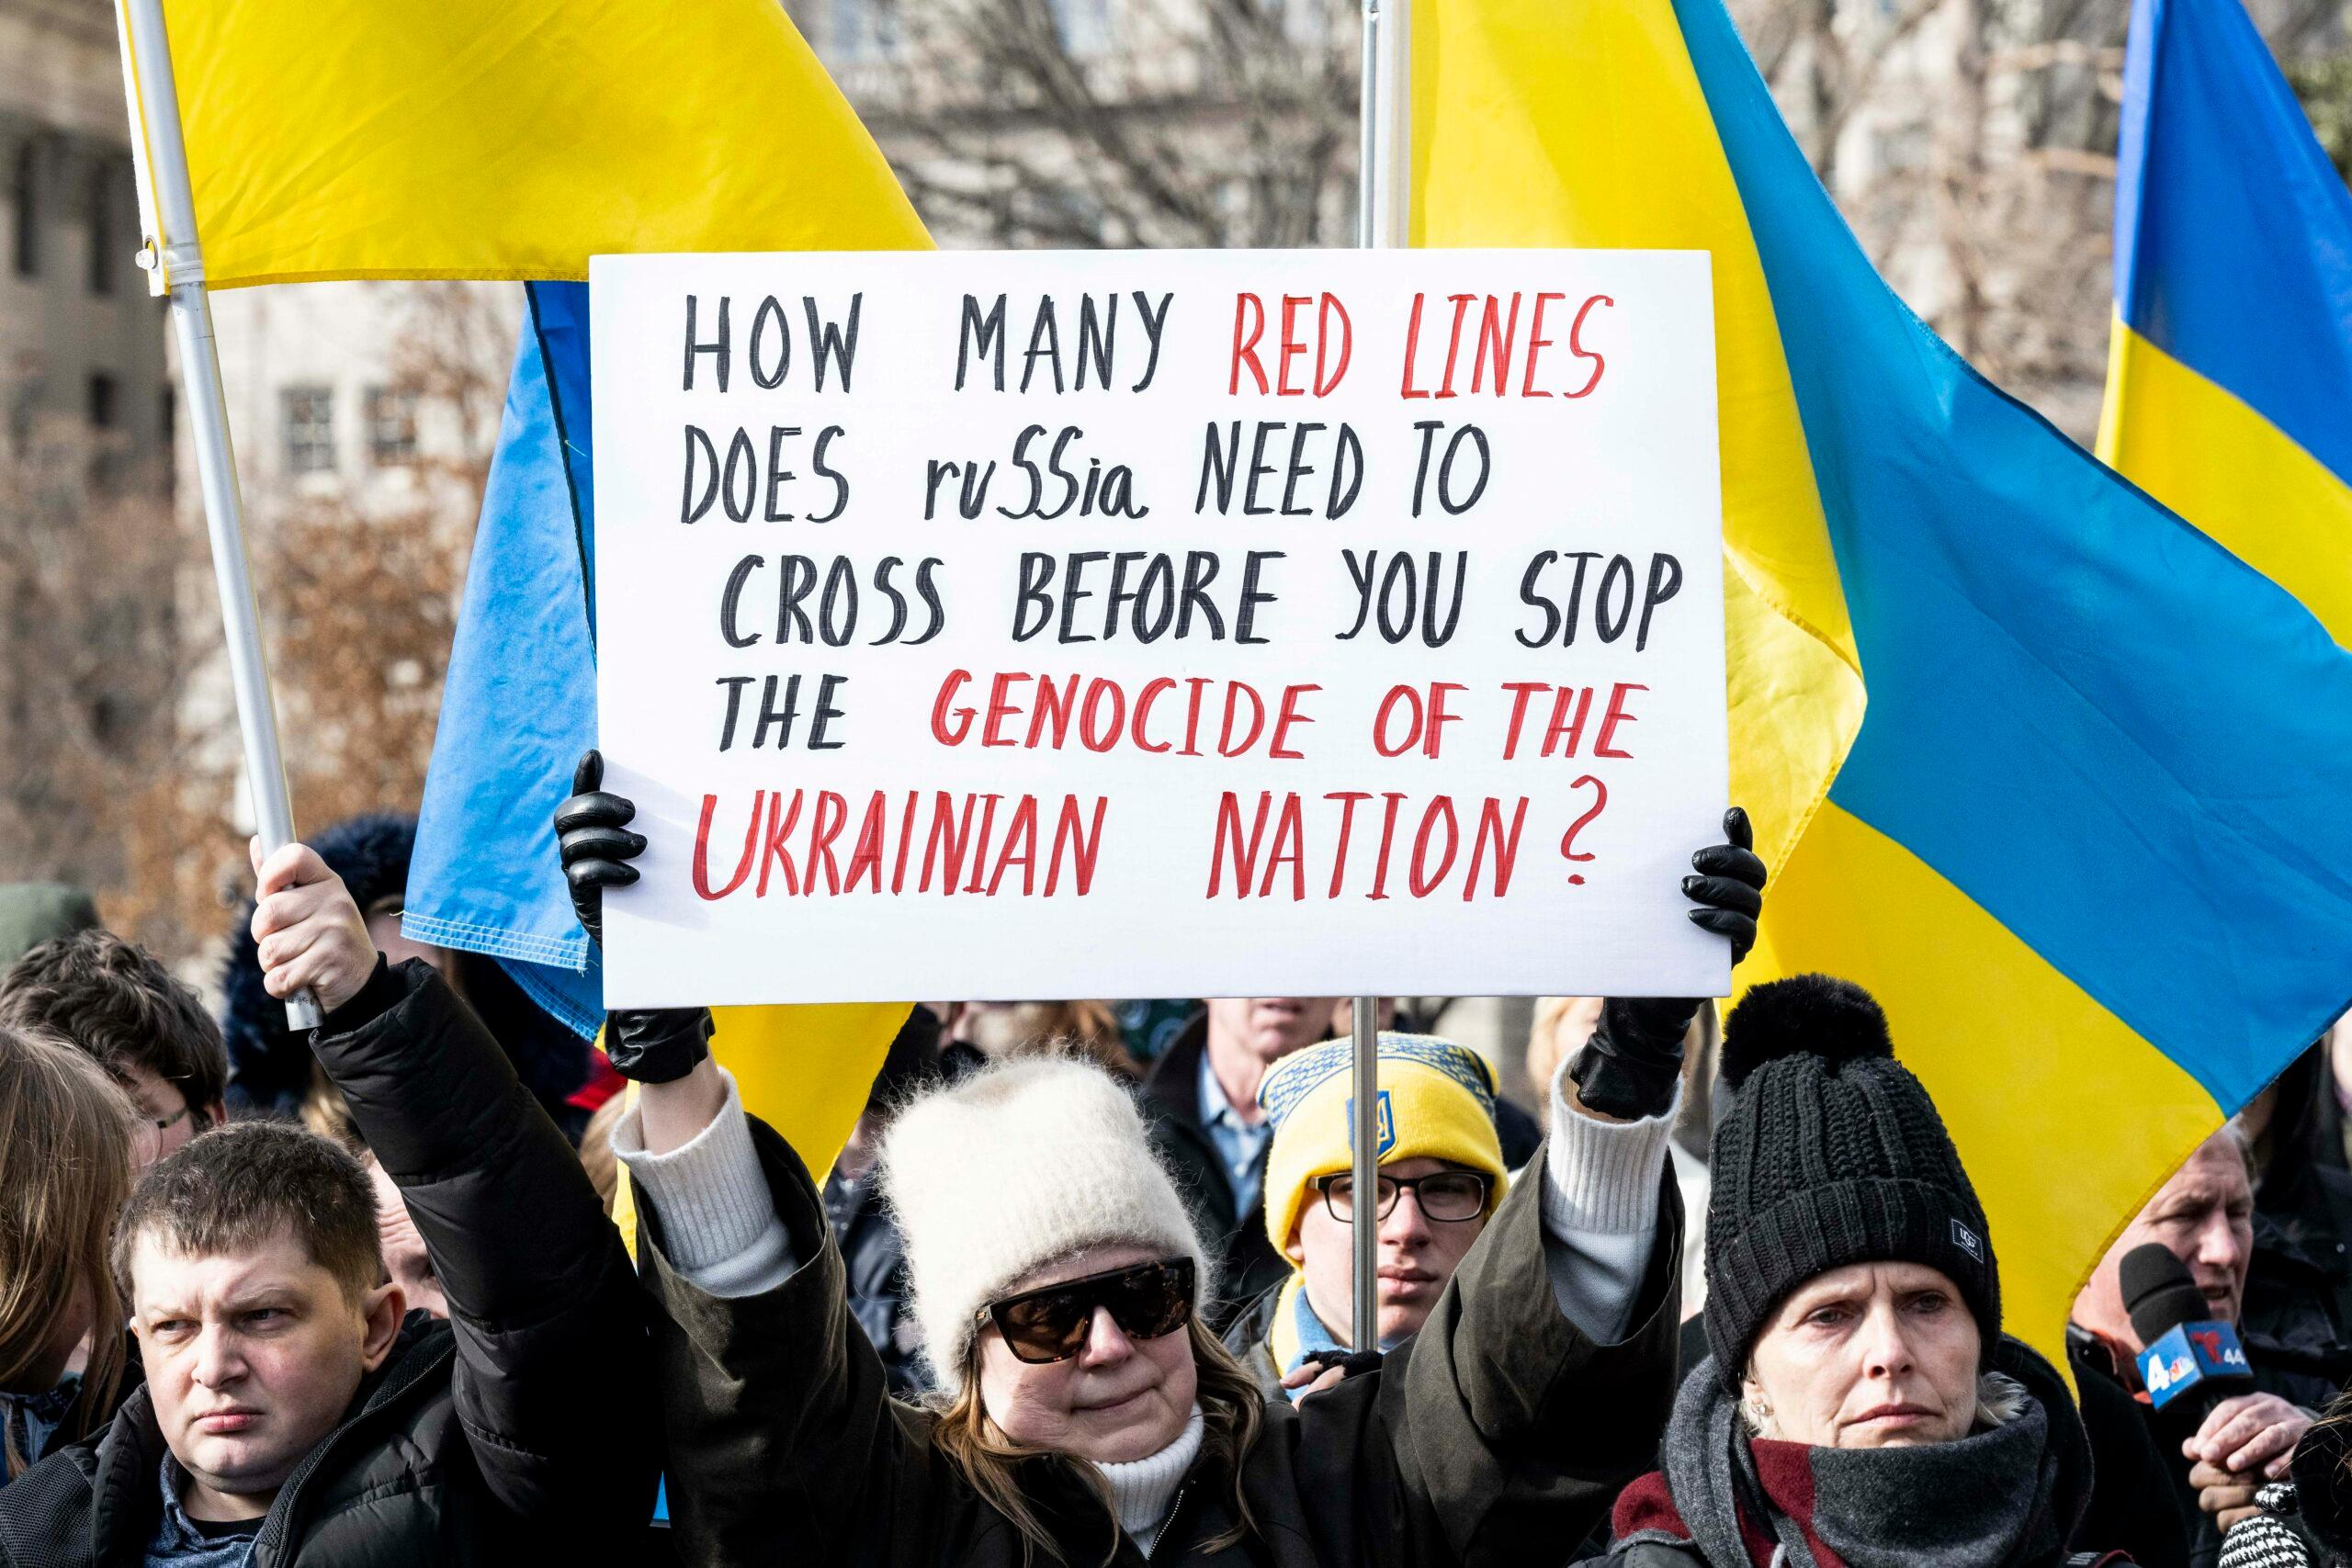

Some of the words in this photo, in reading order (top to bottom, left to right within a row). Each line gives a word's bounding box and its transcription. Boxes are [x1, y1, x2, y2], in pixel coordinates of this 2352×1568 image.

[684, 293, 864, 394] HOW
[956, 292, 1174, 396] MANY
[1229, 293, 1353, 399] RED
[1401, 293, 1615, 400] LINES
[682, 425, 850, 525] DOES
[1195, 421, 1365, 521] NEED
[1412, 421, 1492, 519] TO
[720, 554, 945, 649] CROSS
[1012, 551, 1287, 645] BEFORE
[1335, 549, 1469, 649] YOU
[1515, 550, 1684, 654] STOP
[716, 674, 850, 753] THE
[931, 669, 1324, 761] GENOCIDE
[1374, 682, 1470, 761] OF
[1501, 682, 1651, 761] THE
[692, 789, 1109, 902] UKRAINIAN
[2147, 1354, 2170, 1393] 4
[2224, 1348, 2245, 1365] 44
